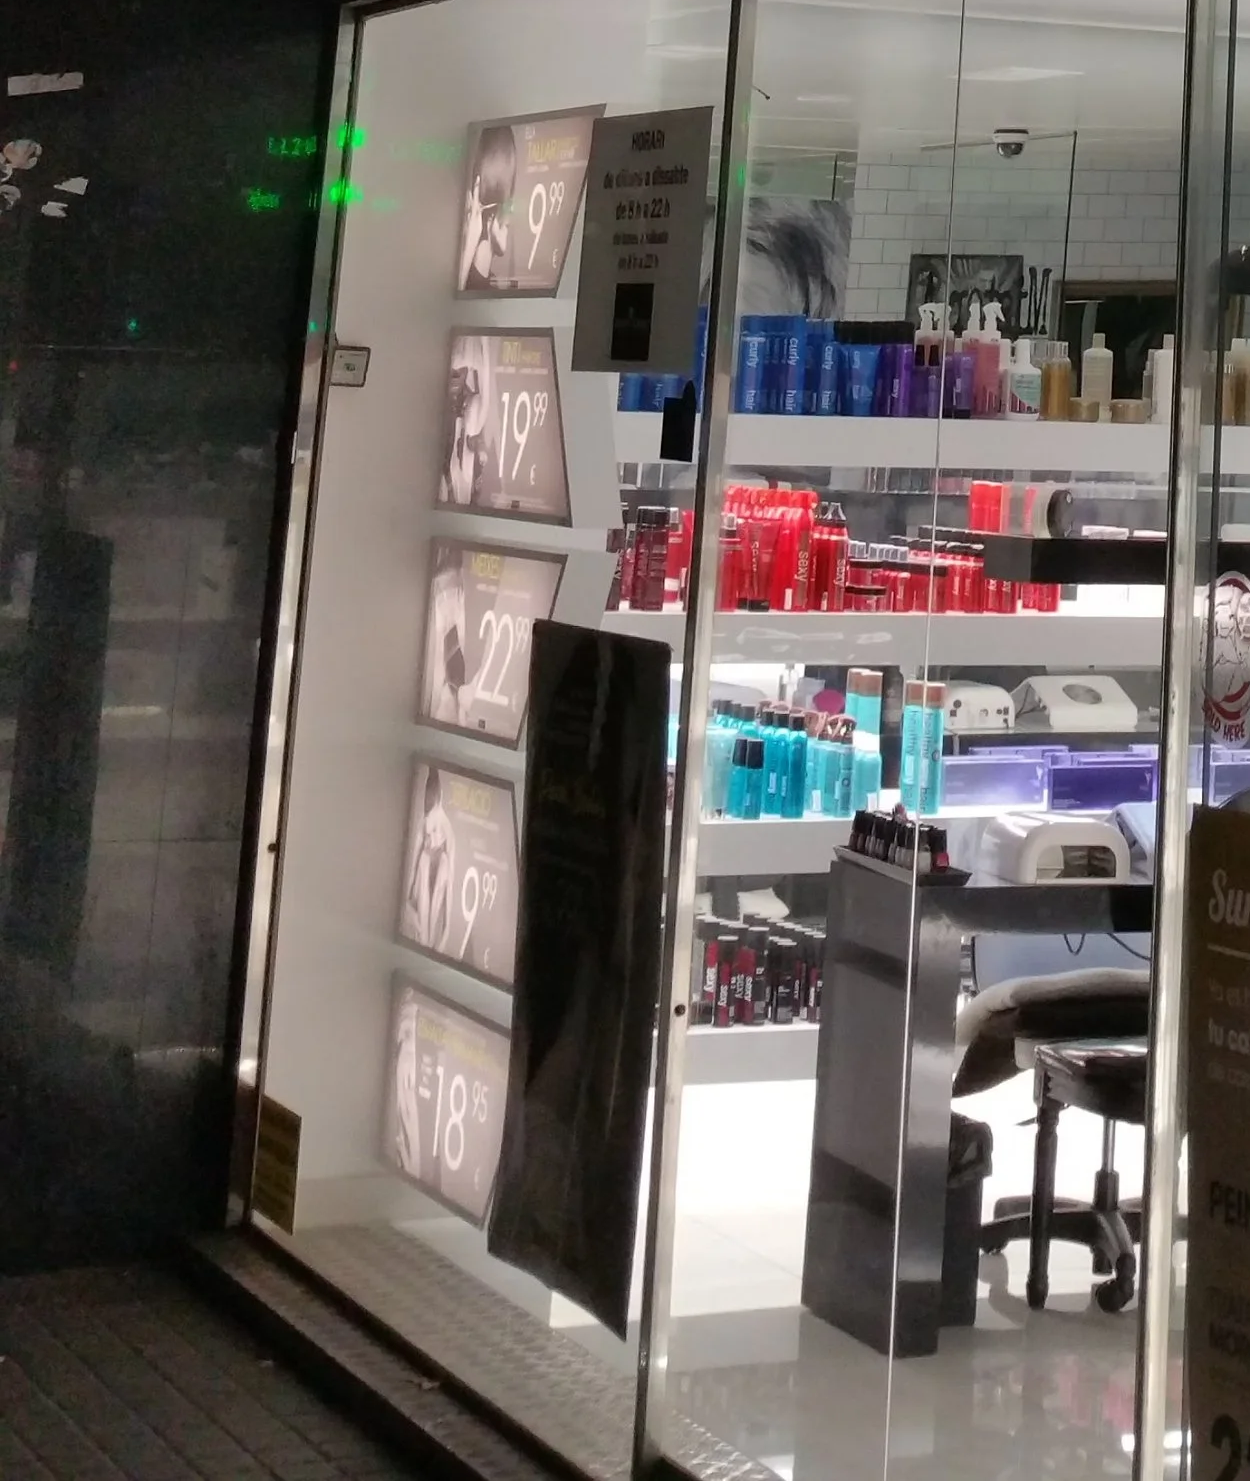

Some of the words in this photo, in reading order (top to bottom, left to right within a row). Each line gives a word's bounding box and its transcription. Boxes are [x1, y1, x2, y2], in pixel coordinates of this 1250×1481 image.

[528, 183, 547, 270] 9
[549, 181, 564, 215] 99
[787, 337, 799, 366] curly
[822, 345, 833, 371] curly
[745, 389, 756, 411] hair
[785, 389, 796, 412] hair
[821, 390, 831, 411] hair
[498, 391, 531, 481] 19
[533, 392, 548, 427] 99
[795, 550, 809, 582] sexy
[833, 558, 845, 587] sexy
[475, 609, 514, 707] 22
[515, 615, 530, 654] 99
[1223, 719, 1246, 742] HERE
[459, 866, 479, 960] 9
[481, 871, 497, 910] 99
[718, 985, 728, 1006] sexy
[1208, 1017, 1224, 1047] tu
[432, 1065, 467, 1171] 18
[472, 1080, 489, 1124] 95
